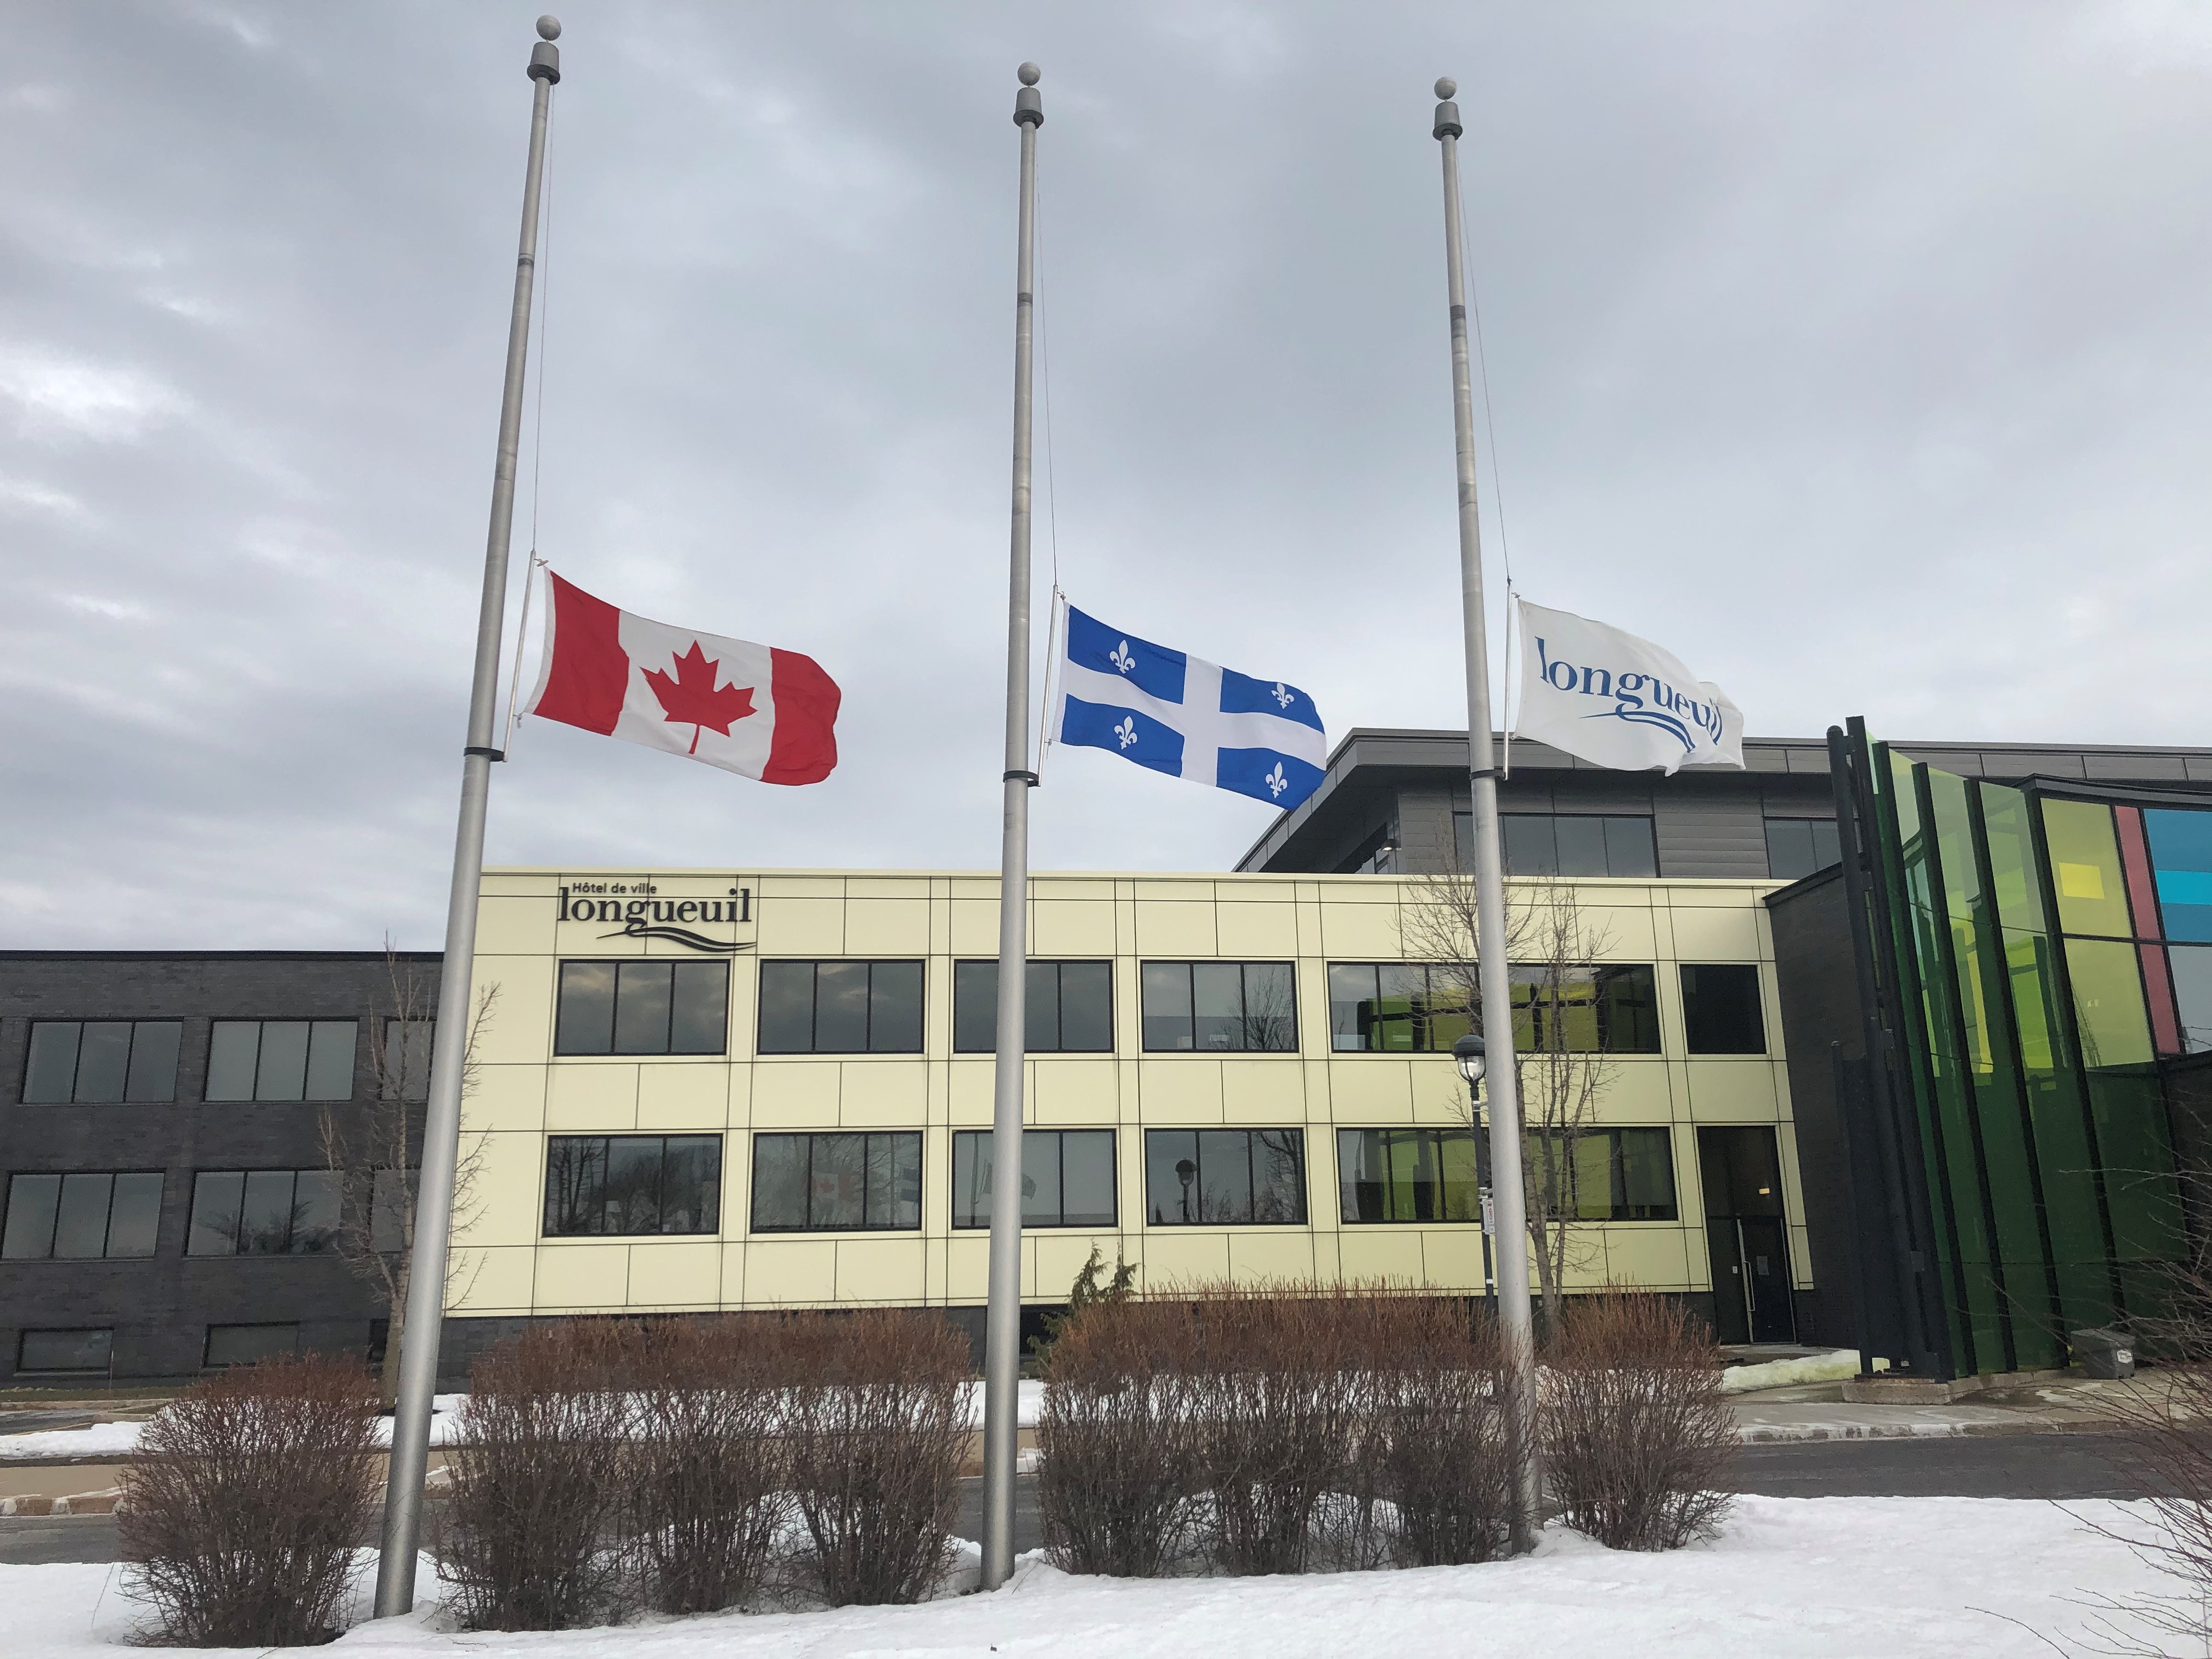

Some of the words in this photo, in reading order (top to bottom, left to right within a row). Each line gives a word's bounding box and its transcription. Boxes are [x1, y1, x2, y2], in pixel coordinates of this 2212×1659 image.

[1534, 636, 1723, 746] longueuil
[557, 887, 752, 936] longueuil
[572, 882, 607, 893] Hôtel
[611, 883, 627, 894] de
[631, 882, 657, 894] ville
